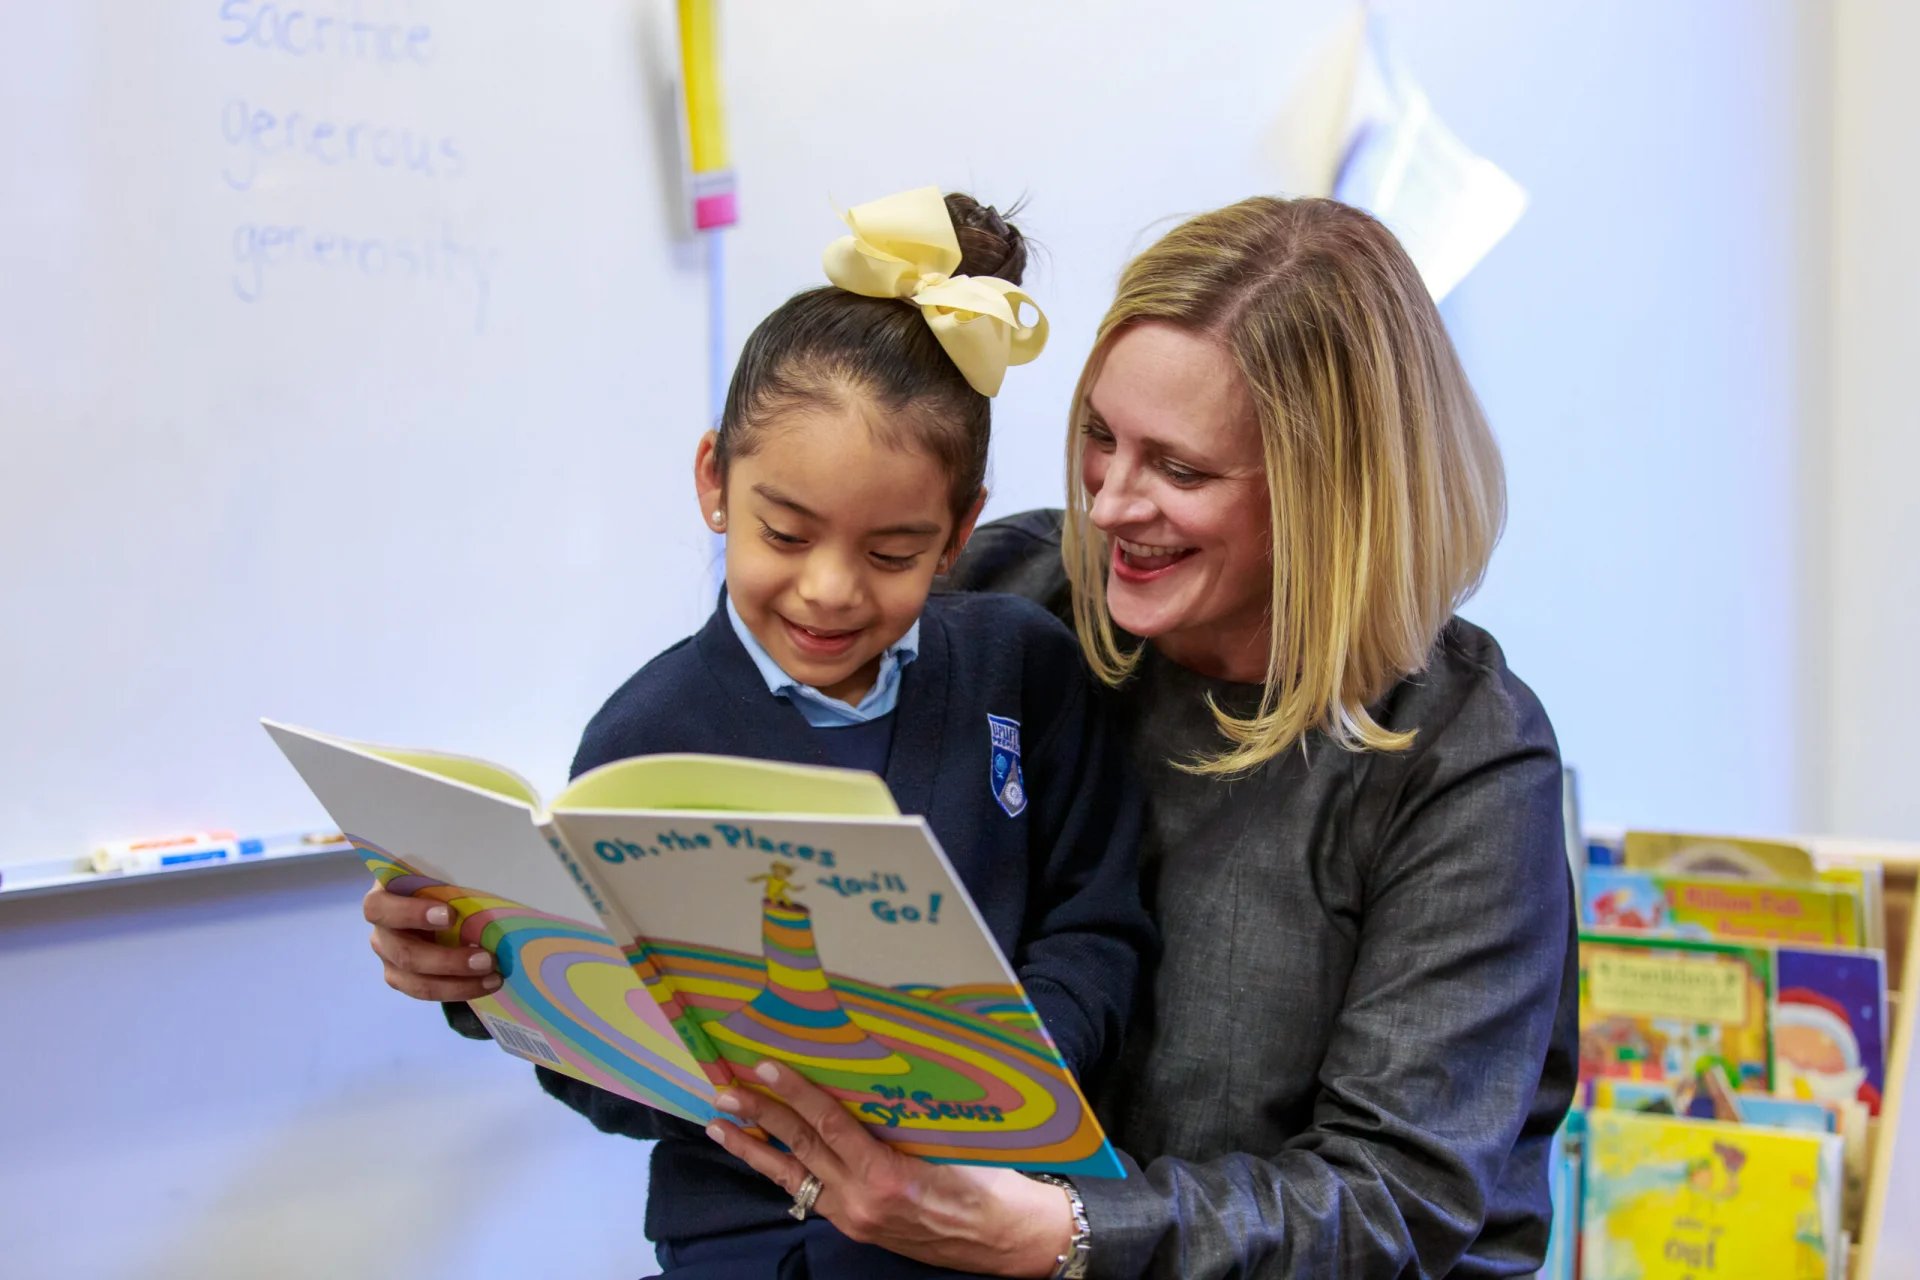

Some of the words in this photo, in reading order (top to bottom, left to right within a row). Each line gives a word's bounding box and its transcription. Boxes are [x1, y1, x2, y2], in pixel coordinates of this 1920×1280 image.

[221, 97, 467, 191] generous
[593, 836, 659, 865] Oh,
[657, 829, 711, 852] the
[713, 823, 837, 868] Places
[816, 871, 908, 898] You'll
[869, 890, 942, 925] Go!
[860, 1101, 920, 1129] Dr.
[911, 1089, 1006, 1123] Seuss
